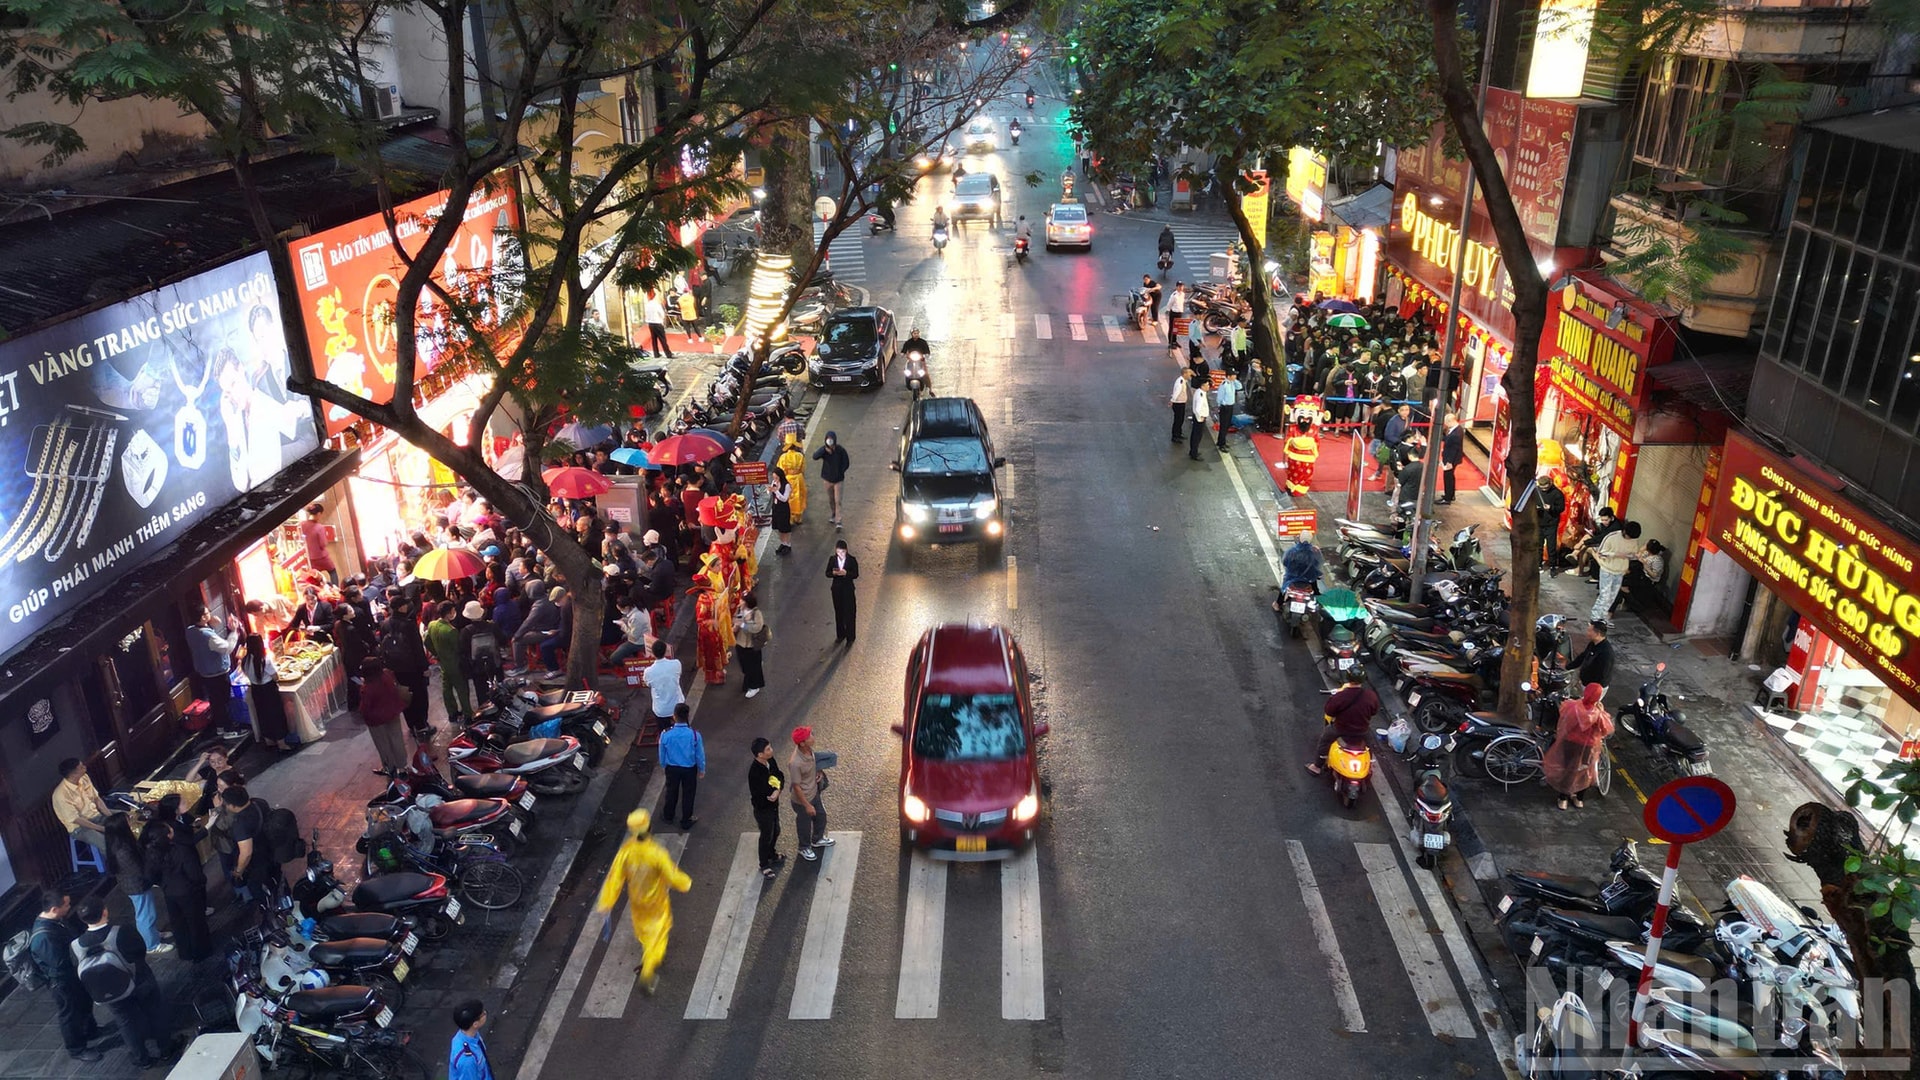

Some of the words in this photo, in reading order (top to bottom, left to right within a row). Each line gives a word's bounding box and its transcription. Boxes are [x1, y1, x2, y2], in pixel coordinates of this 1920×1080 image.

[329, 242, 353, 267] BẢO
[352, 234, 372, 257] TÍN
[371, 229, 393, 250] MIN
[28, 344, 94, 385] VÀNG
[94, 316, 161, 361] TRANG
[162, 303, 199, 335] SỨC
[198, 291, 238, 320] NAM
[238, 271, 272, 303] GIỚI
[1556, 311, 1593, 366] THỊNH
[1591, 333, 1638, 396] QUANG
[1574, 371, 1586, 392] TÍN
[9, 588, 49, 624] GIÚP
[52, 562, 90, 598] PHÁI
[92, 535, 135, 574] MẠNH
[135, 511, 171, 544] THÊM
[172, 491, 207, 523] SANG
[1730, 476, 1802, 545] ĐỨC
[1803, 528, 1920, 638] HÙNG
[1761, 466, 1785, 488] CÔNG
[1784, 483, 1796, 494] TY
[1796, 489, 1820, 511] TNHH
[1819, 505, 1841, 525] BẢO
[1841, 518, 1857, 536] TÍN
[1858, 529, 1881, 551] ĐỨC
[1735, 517, 1767, 557] VÀNG
[1768, 544, 1809, 589] TRANG
[1837, 597, 1868, 633] CAO
[1869, 623, 1902, 657] CẤP
